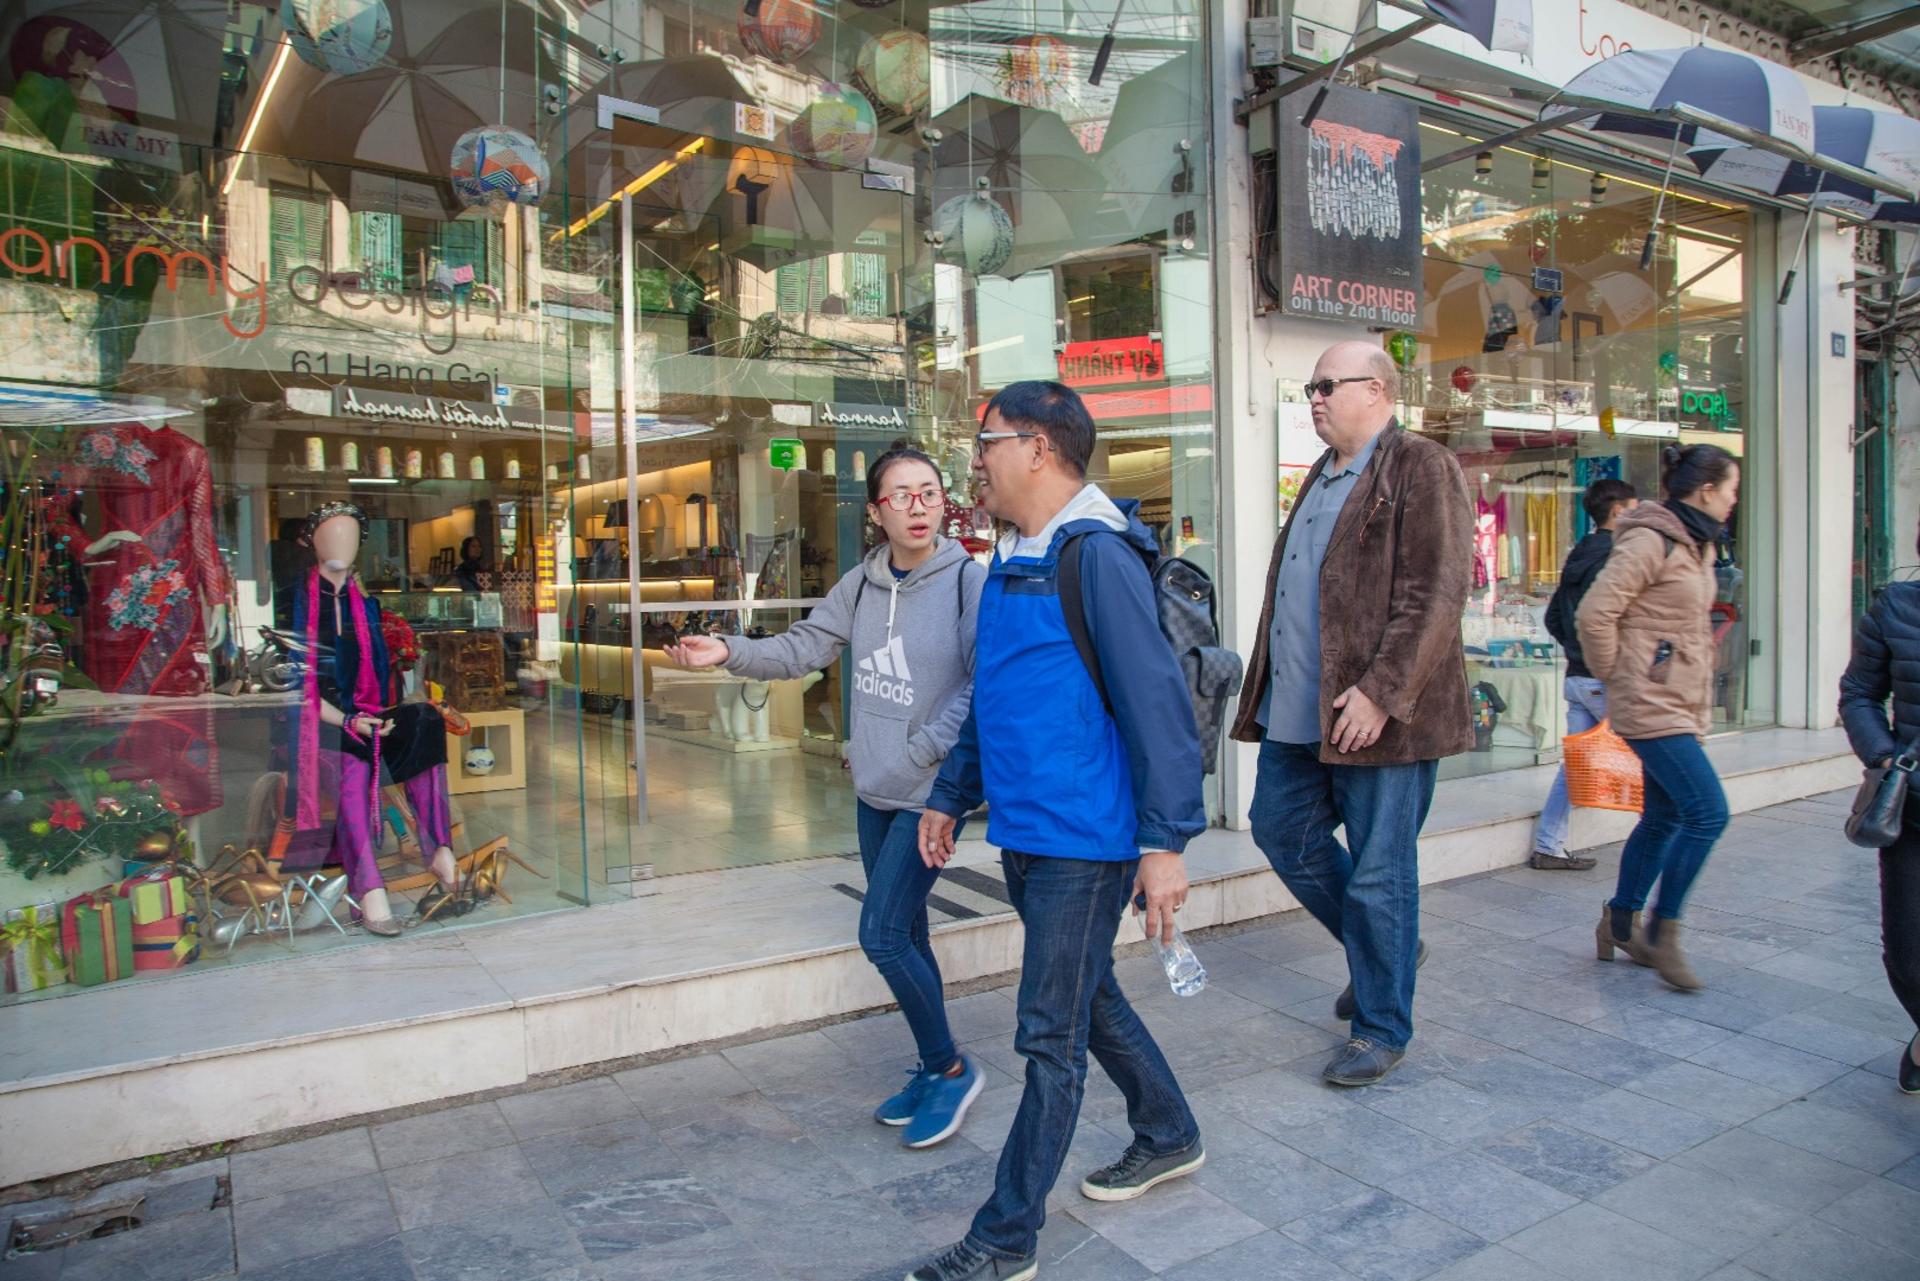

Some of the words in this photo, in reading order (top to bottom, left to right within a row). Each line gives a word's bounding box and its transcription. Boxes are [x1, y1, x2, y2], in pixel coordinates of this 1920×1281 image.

[289, 264, 501, 355] design
[1291, 273, 1333, 299] ART
[1337, 280, 1417, 314] CORNER
[1291, 296, 1313, 310] on
[1316, 298, 1344, 316] the
[1349, 302, 1377, 320] 2nd
[1381, 304, 1417, 326] floor
[291, 350, 329, 377] 61
[347, 352, 434, 395] Hang
[447, 362, 500, 390] Gai
[854, 671, 915, 706] adidas
